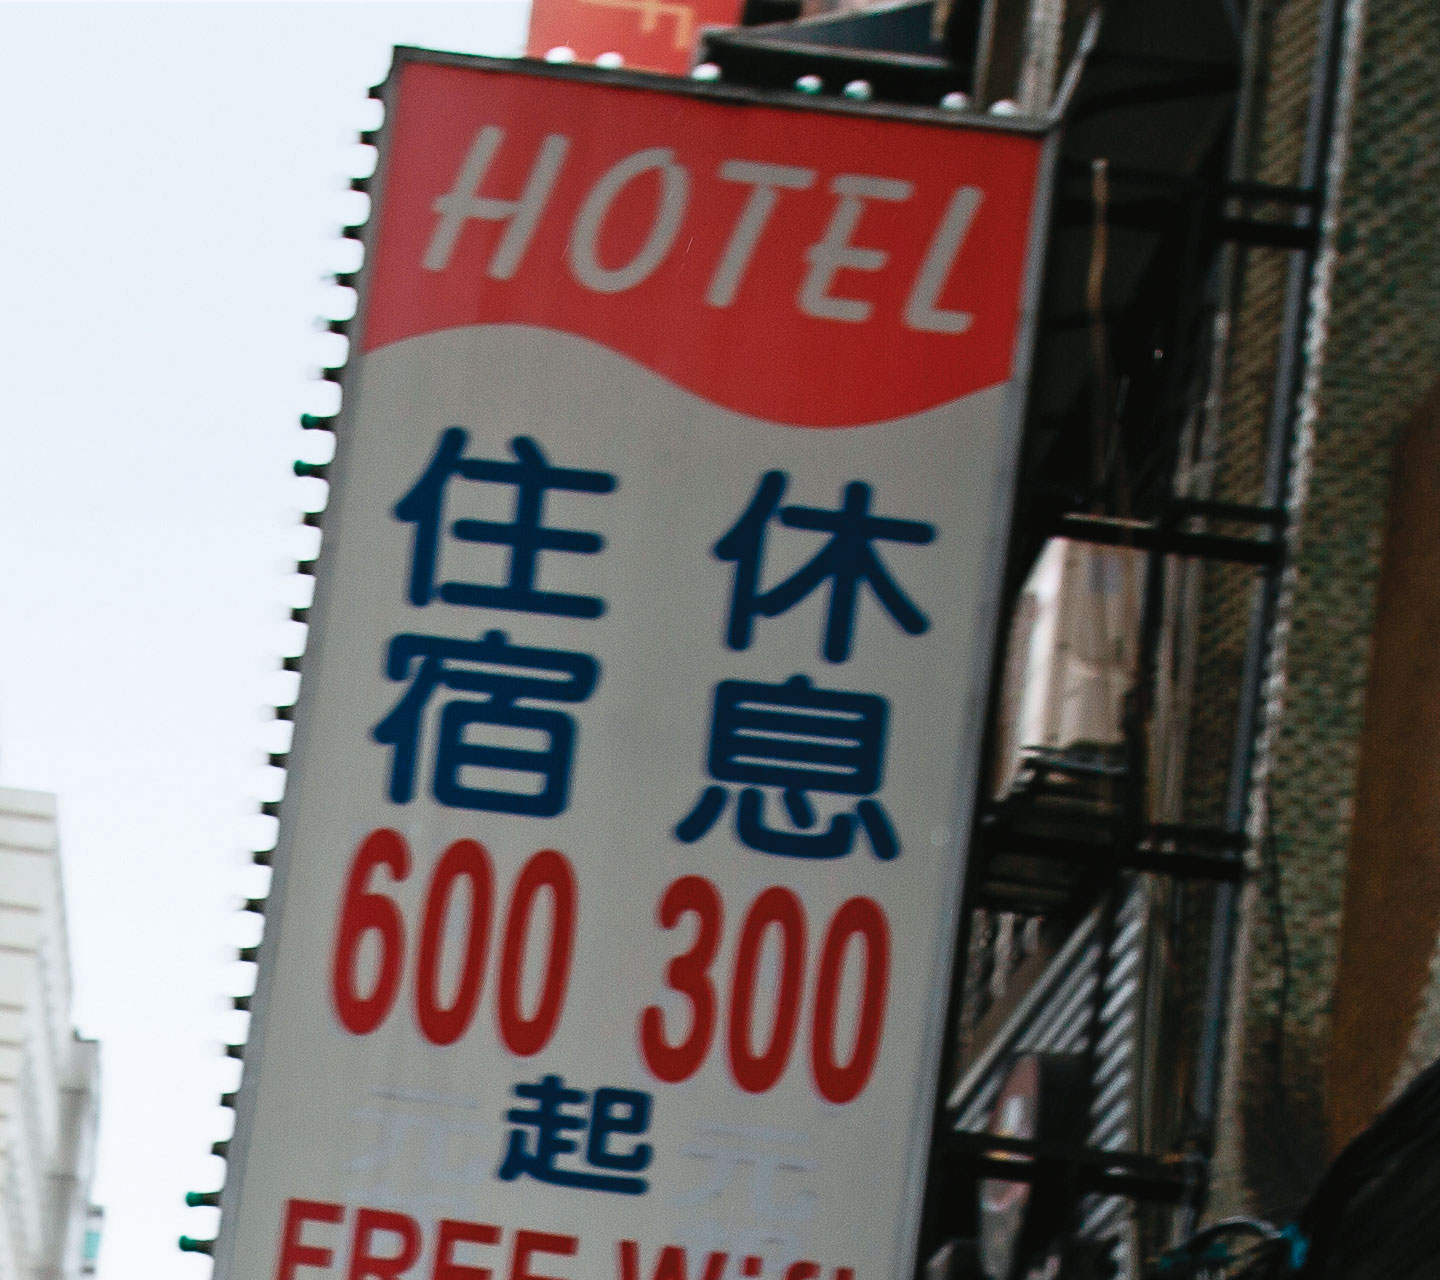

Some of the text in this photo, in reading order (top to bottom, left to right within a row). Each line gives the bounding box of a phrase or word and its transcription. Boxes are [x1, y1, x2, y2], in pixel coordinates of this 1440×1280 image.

[420, 123, 986, 335] HOTEL
[373, 424, 618, 819] 住宿
[673, 468, 937, 863] 休息
[331, 827, 578, 1058] 600
[638, 872, 892, 1106] 300
[497, 1075, 653, 1197] 起
